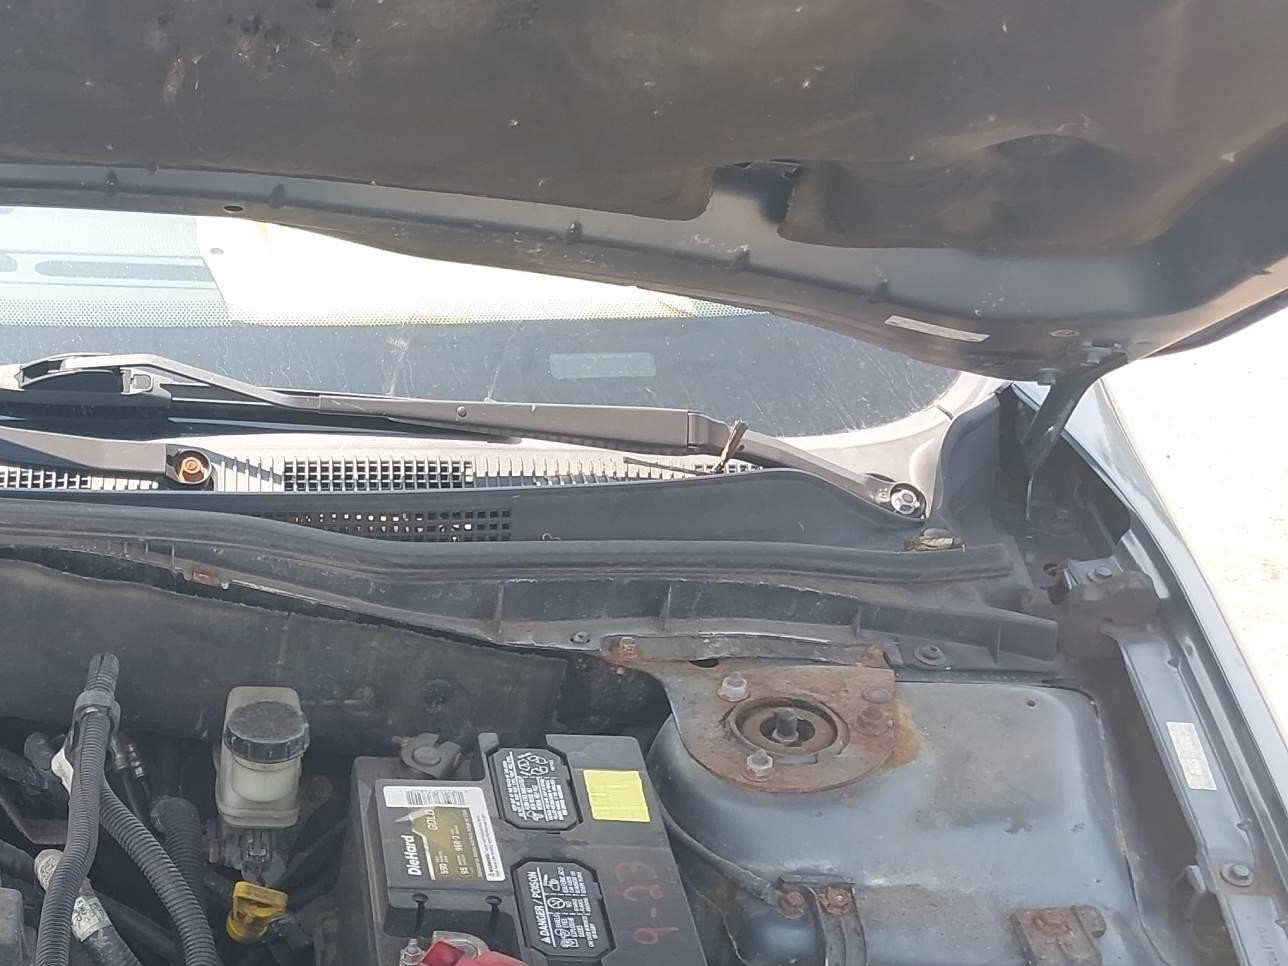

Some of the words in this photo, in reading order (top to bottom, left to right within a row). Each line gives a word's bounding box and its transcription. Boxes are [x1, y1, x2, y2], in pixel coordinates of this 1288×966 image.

[425, 809, 438, 831] GOLD
[400, 835, 422, 876] DieHard
[528, 871, 541, 898] POISON
[534, 905, 550, 936] DANGER
